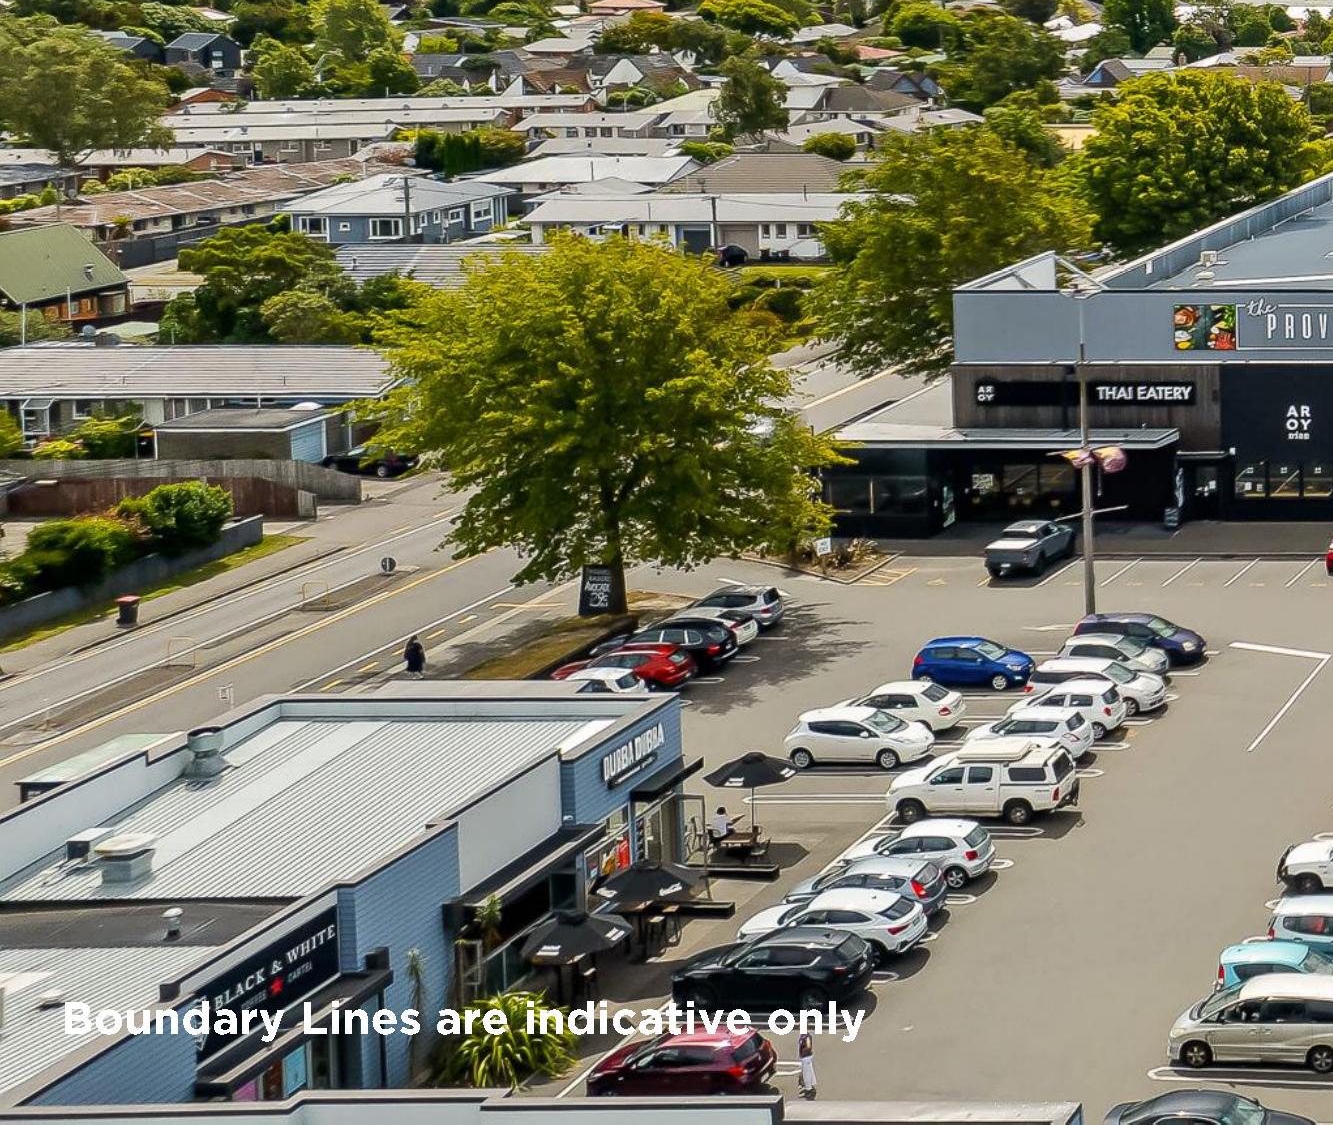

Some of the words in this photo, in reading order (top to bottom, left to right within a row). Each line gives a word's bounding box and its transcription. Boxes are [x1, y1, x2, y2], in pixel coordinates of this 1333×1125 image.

[1245, 298, 1278, 317] the
[1096, 386, 1134, 401] THAI
[1137, 386, 1193, 401] EATERY
[1286, 404, 1311, 418] AR
[1285, 418, 1312, 431] OY
[213, 967, 266, 1011] BLACK
[271, 960, 284, 975] &
[286, 924, 336, 964] WHITE
